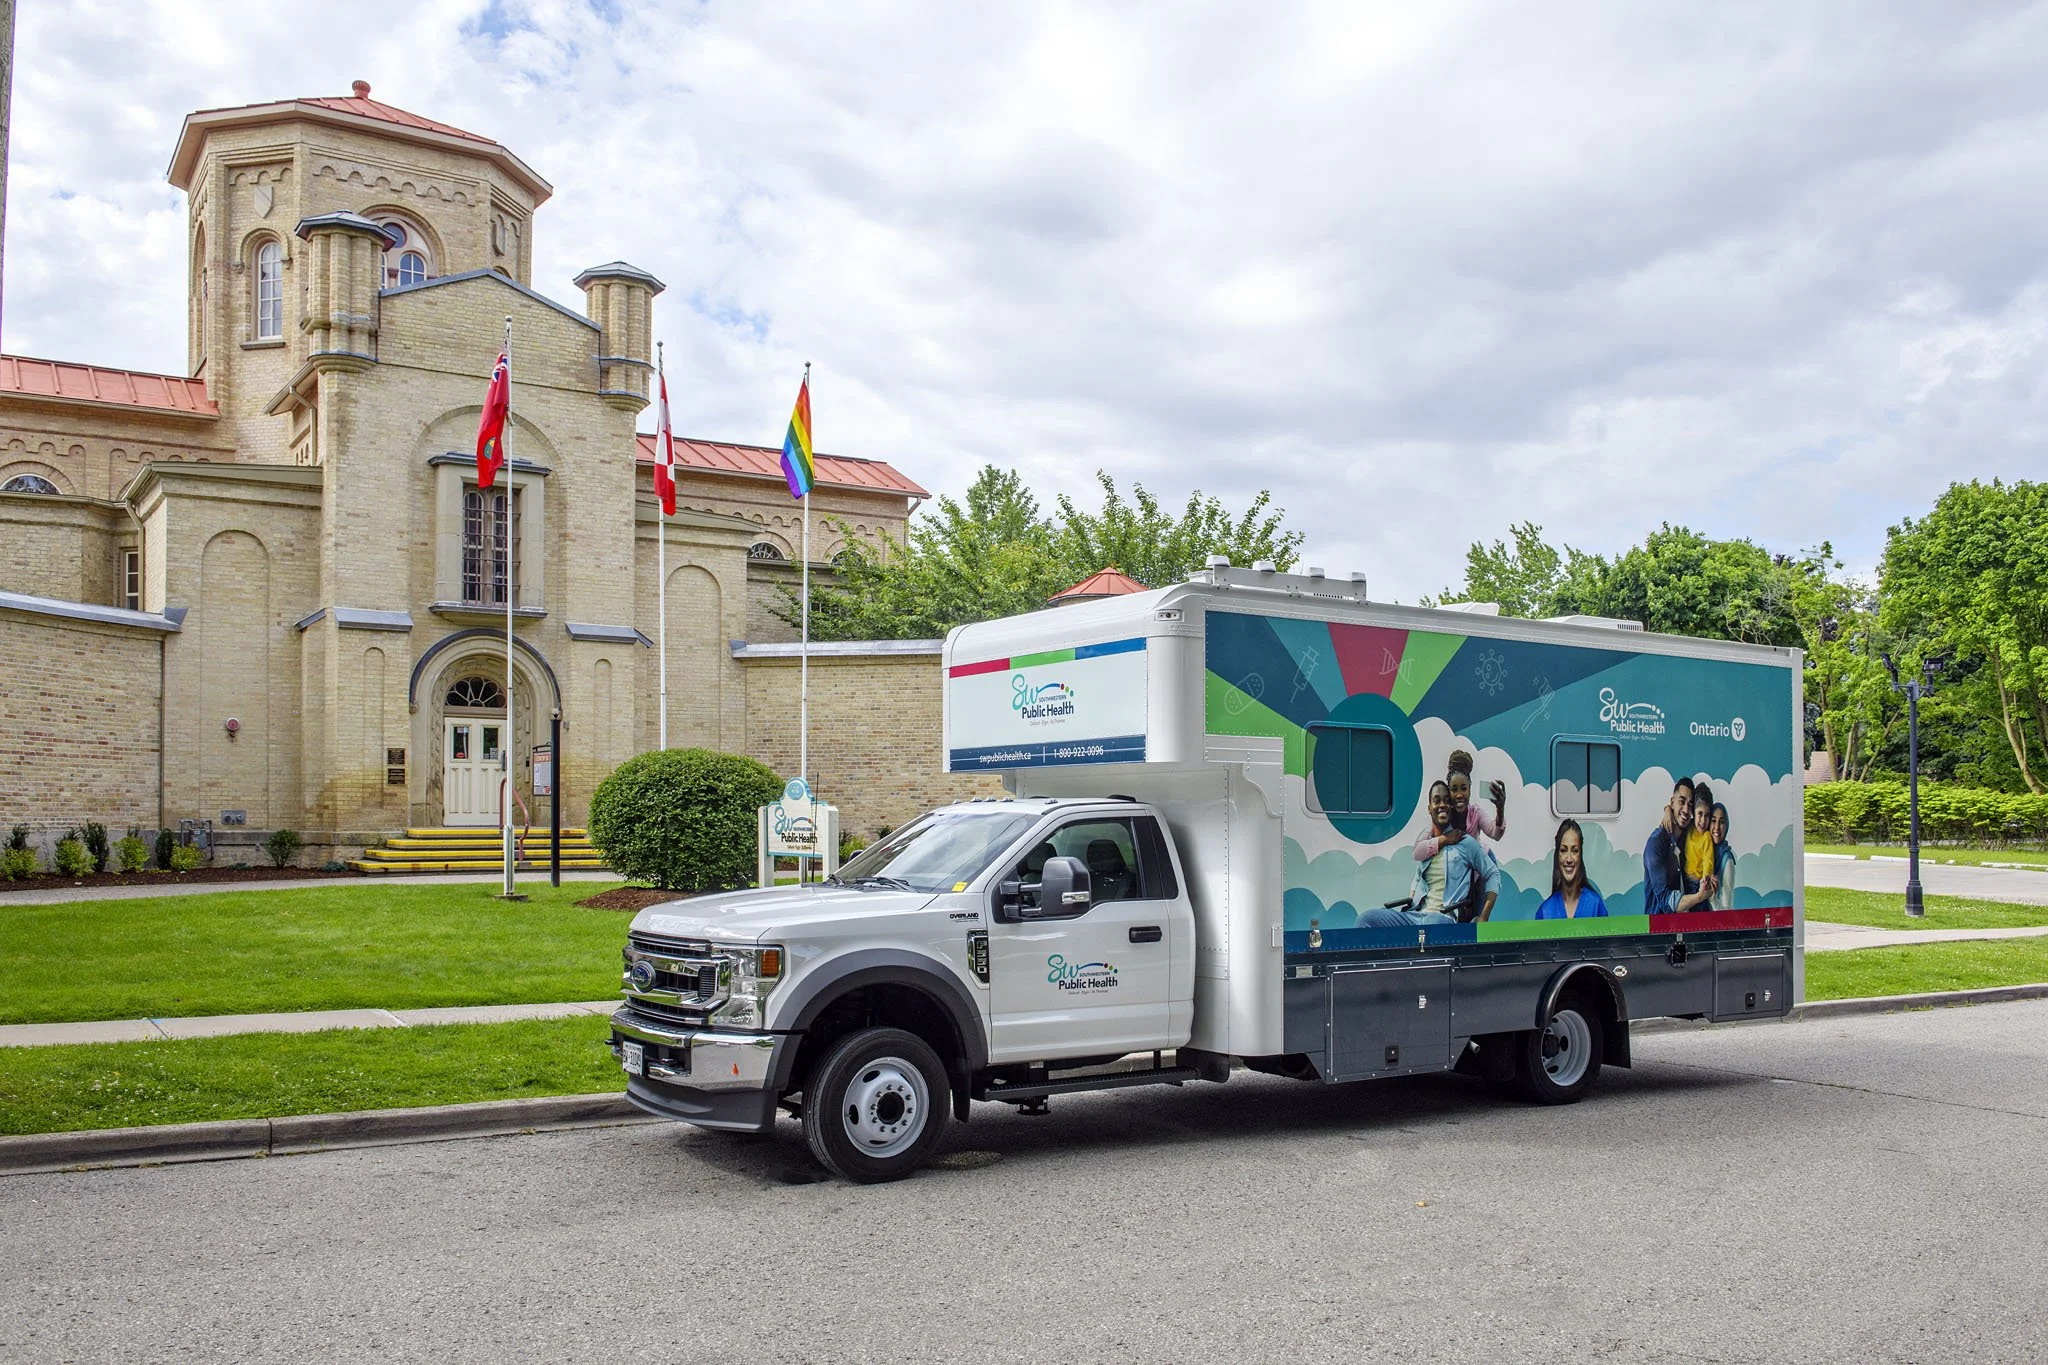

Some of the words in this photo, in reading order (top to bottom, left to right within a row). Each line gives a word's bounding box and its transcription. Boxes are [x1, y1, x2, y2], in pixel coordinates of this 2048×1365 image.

[1022, 704, 1046, 719] Public
[1046, 701, 1074, 717] Health
[1610, 719, 1636, 733] Public
[1637, 720, 1665, 734] Health
[1690, 721, 1730, 737] Ontario
[979, 751, 1032, 765] swpublichealth.ca
[1053, 745, 1104, 759] 1-800-922-0096
[781, 832, 798, 843] Public
[798, 832, 818, 844] Health
[1058, 978, 1087, 990] Public
[1088, 976, 1118, 988] Health
